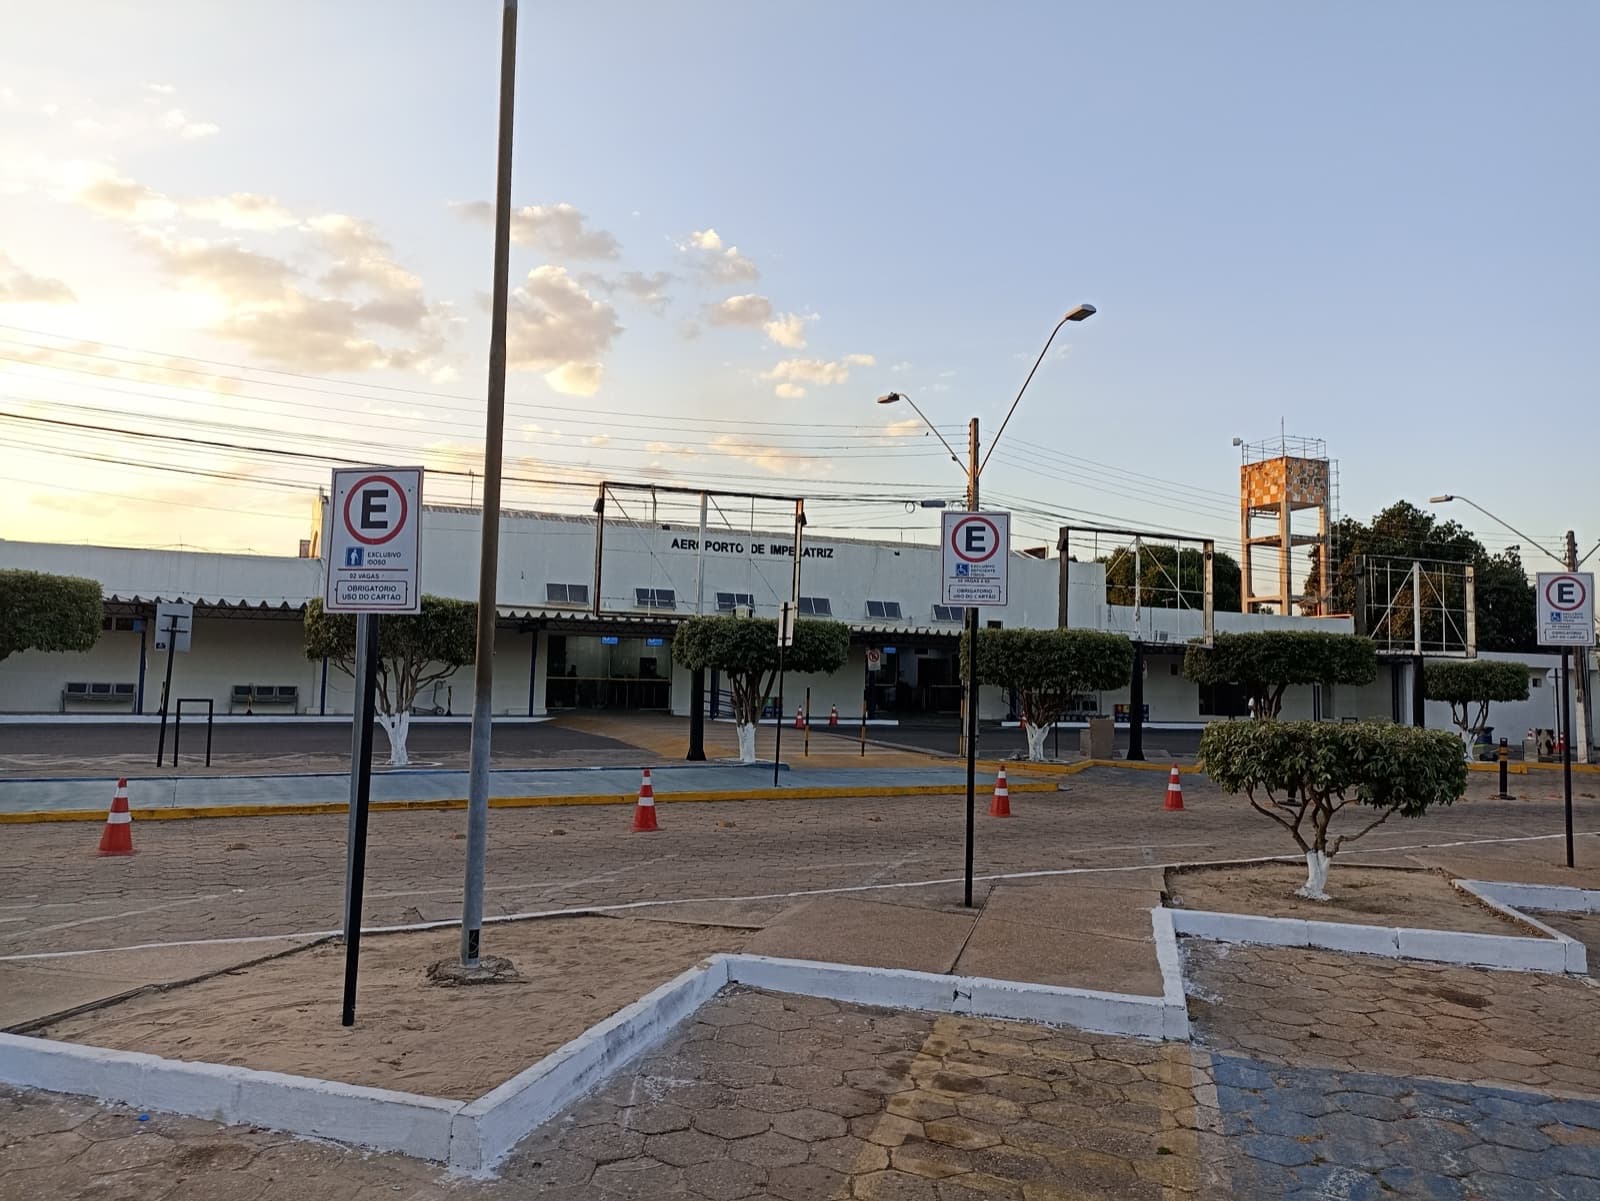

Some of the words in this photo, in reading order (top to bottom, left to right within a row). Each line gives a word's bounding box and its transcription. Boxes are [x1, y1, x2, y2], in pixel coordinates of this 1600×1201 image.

[361, 489, 389, 529] E
[751, 543, 765, 554] DE
[770, 544, 834, 558] IMPEATRIZ
[965, 526, 986, 552] E
[1557, 583, 1576, 604] E
